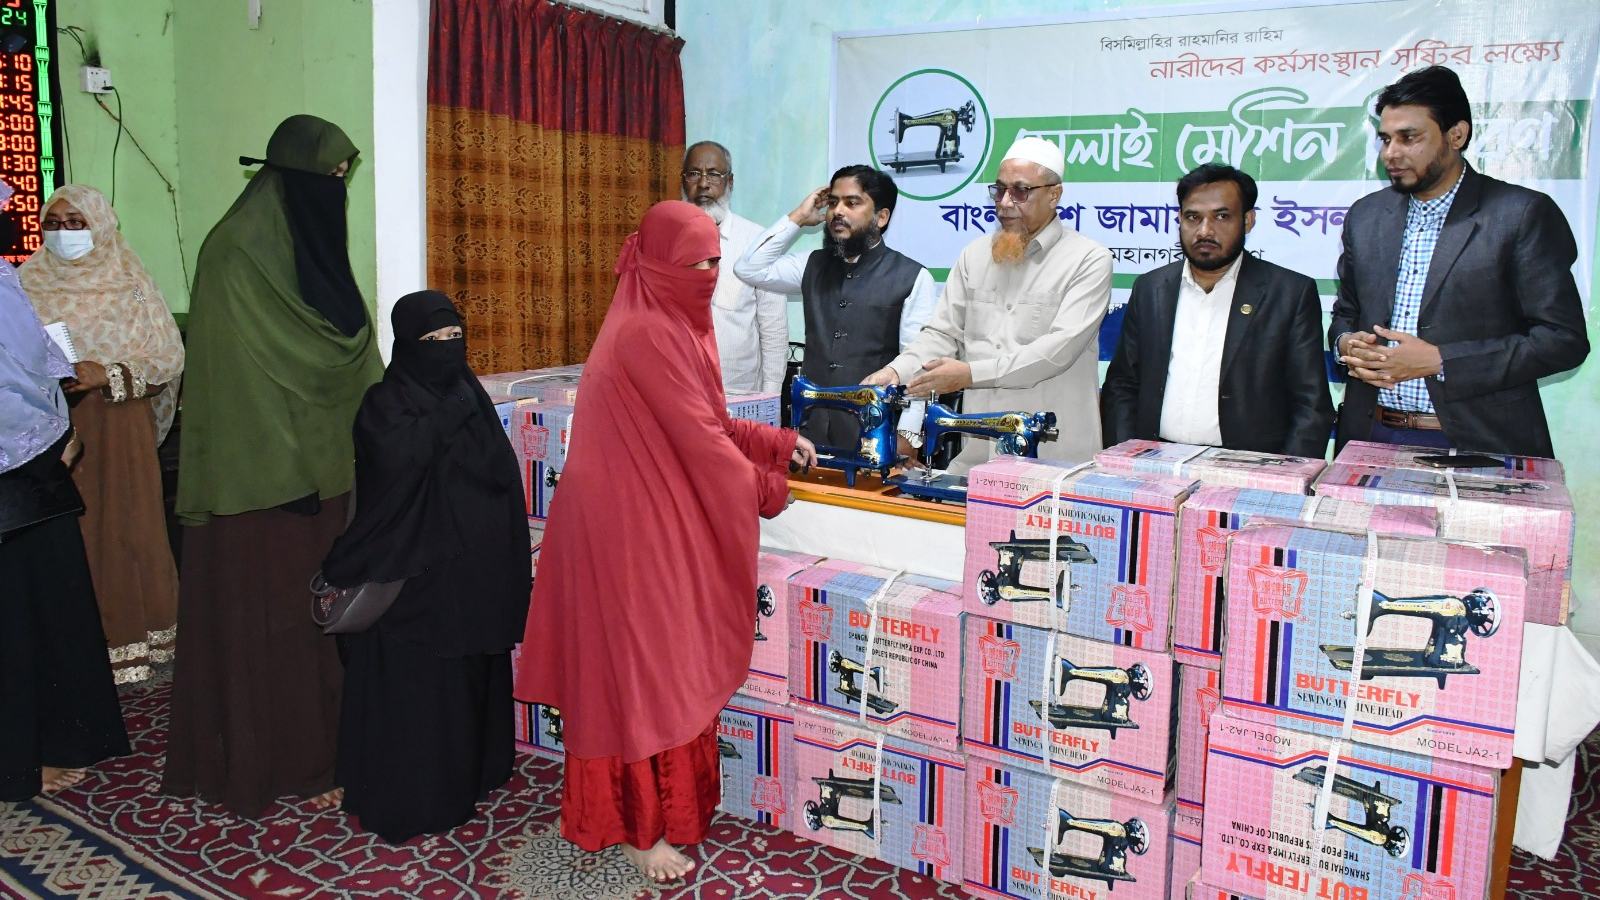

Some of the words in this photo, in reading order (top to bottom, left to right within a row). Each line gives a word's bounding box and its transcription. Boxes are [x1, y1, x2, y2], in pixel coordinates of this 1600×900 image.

[1100, 34, 1172, 52] বিসমিল্লাহির
[1178, 30, 1238, 47] রাহমানির
[1244, 27, 1283, 43] রাহিম
[1149, 52, 1245, 79] নারীদের
[1253, 49, 1381, 77] কর্মসংস্থান
[1390, 39, 1473, 72] সৃষ্টির
[848, 608, 940, 643] BUTERFLY
[1297, 692, 1332, 706] SEWING
[1219, 723, 1248, 736] JA2-1
[1250, 730, 1291, 747] MODEL
[1417, 737, 1462, 755] MODEL
[1464, 747, 1501, 761] JA2-1
[1097, 775, 1127, 790] MODEL
[1128, 782, 1154, 797] JA2-1
[1231, 820, 1254, 833] CHINA
[1255, 827, 1266, 838] OF
[1267, 830, 1304, 851] REPUBLIC
[1287, 852, 1329, 871] BUERFLY
[1343, 849, 1359, 862] THE
[1330, 862, 1370, 881] SHANGHAI
